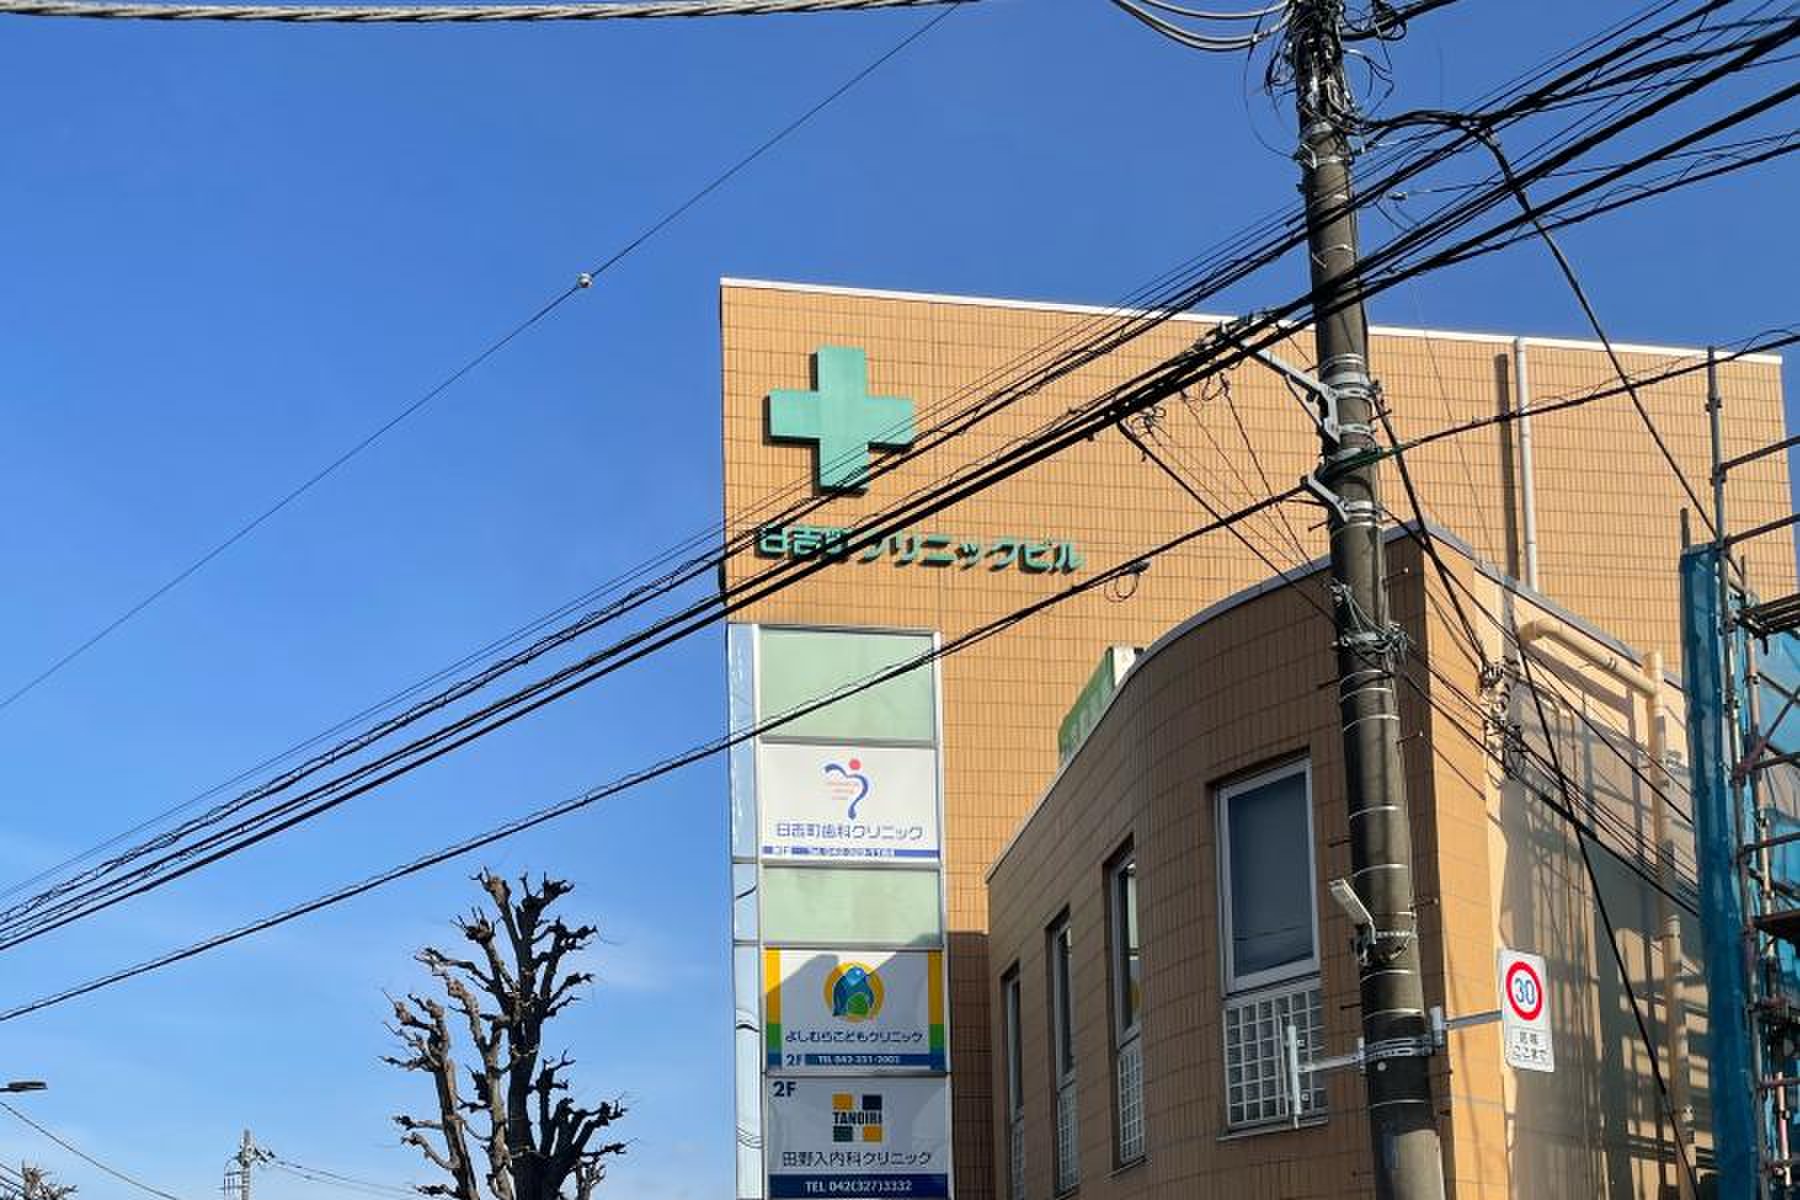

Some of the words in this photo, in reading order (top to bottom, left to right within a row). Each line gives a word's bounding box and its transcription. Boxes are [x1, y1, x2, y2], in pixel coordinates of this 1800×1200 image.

[777, 823, 923, 840] 日吉町歯科クリニック
[1514, 977, 1536, 1005] 30
[785, 1030, 923, 1043] よしむらこどもクリニック
[773, 1081, 797, 1097] 2F
[832, 1111, 882, 1125] TANOIRI
[783, 1152, 932, 1168] 田野入内科クリニック
[804, 1180, 827, 1193] TEL
